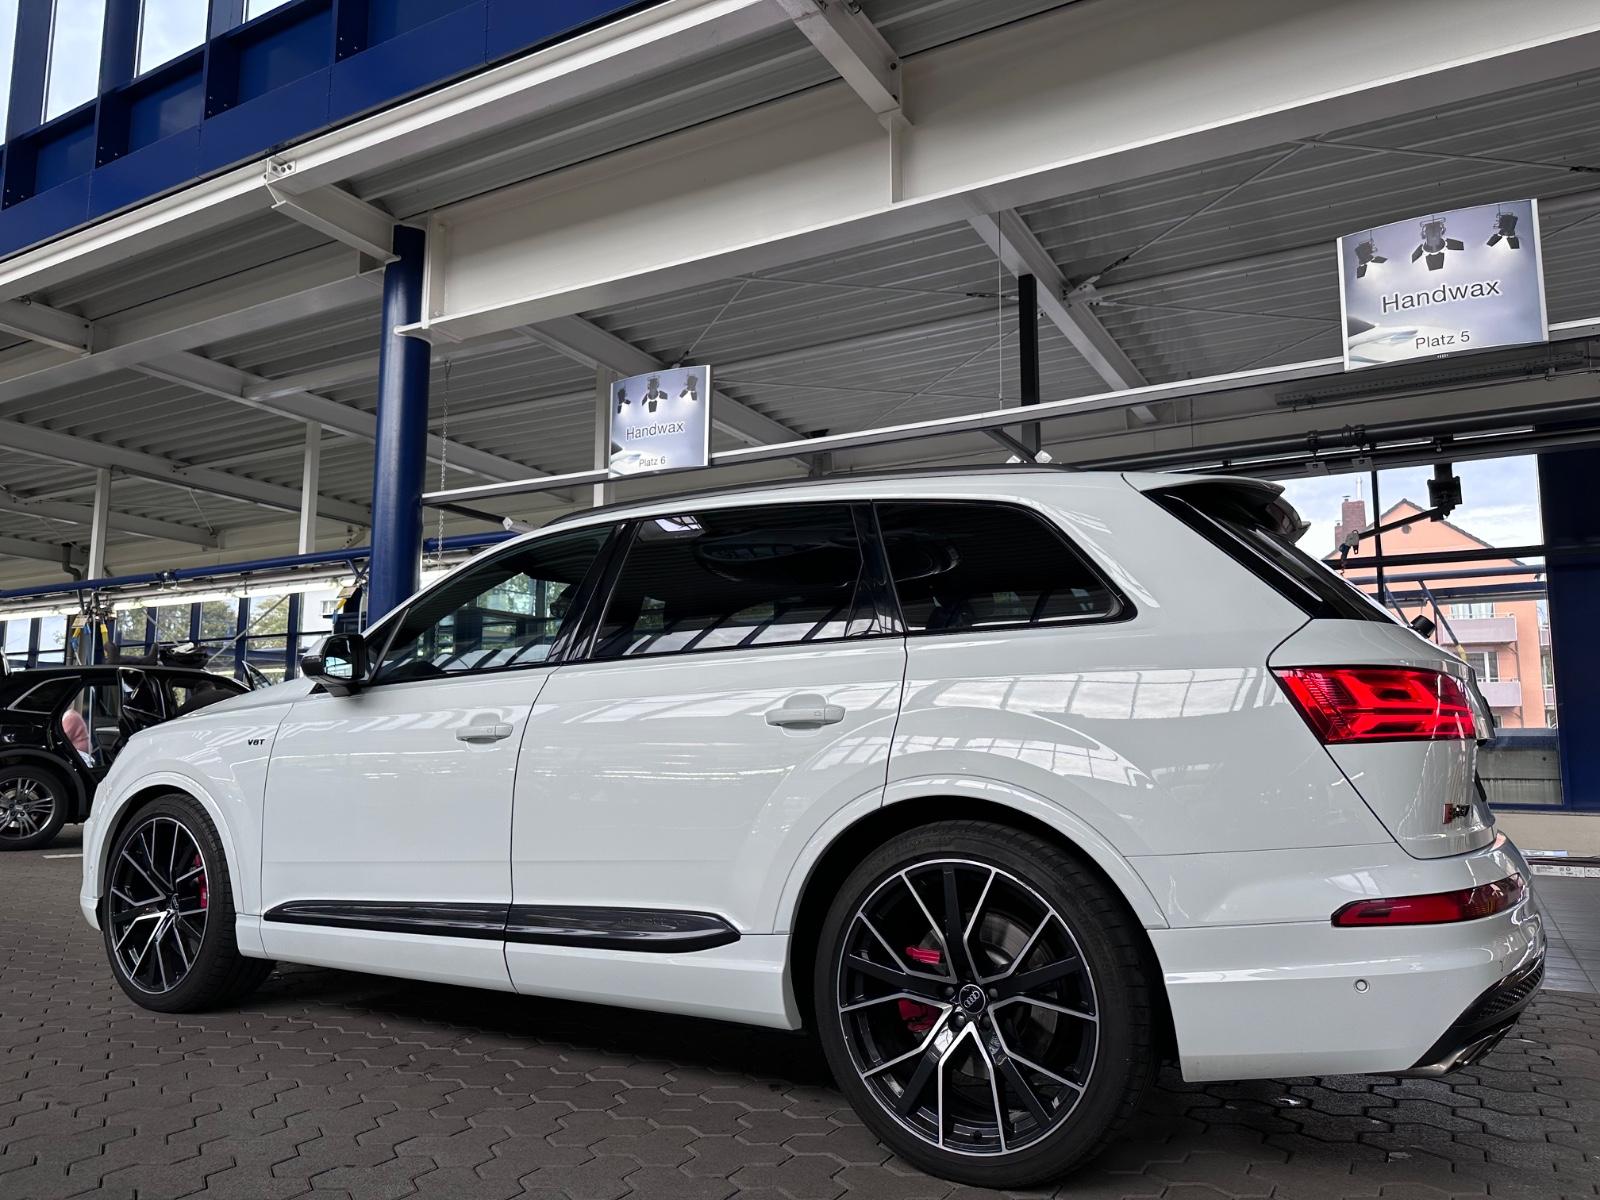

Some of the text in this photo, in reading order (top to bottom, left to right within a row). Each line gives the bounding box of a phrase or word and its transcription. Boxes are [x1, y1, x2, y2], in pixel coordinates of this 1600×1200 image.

[1382, 281, 1500, 313] Handwax
[1416, 330, 1470, 350] Platz 5
[626, 422, 684, 440] Handwax
[639, 456, 666, 467] Platz 6
[248, 738, 266, 746] V8T
